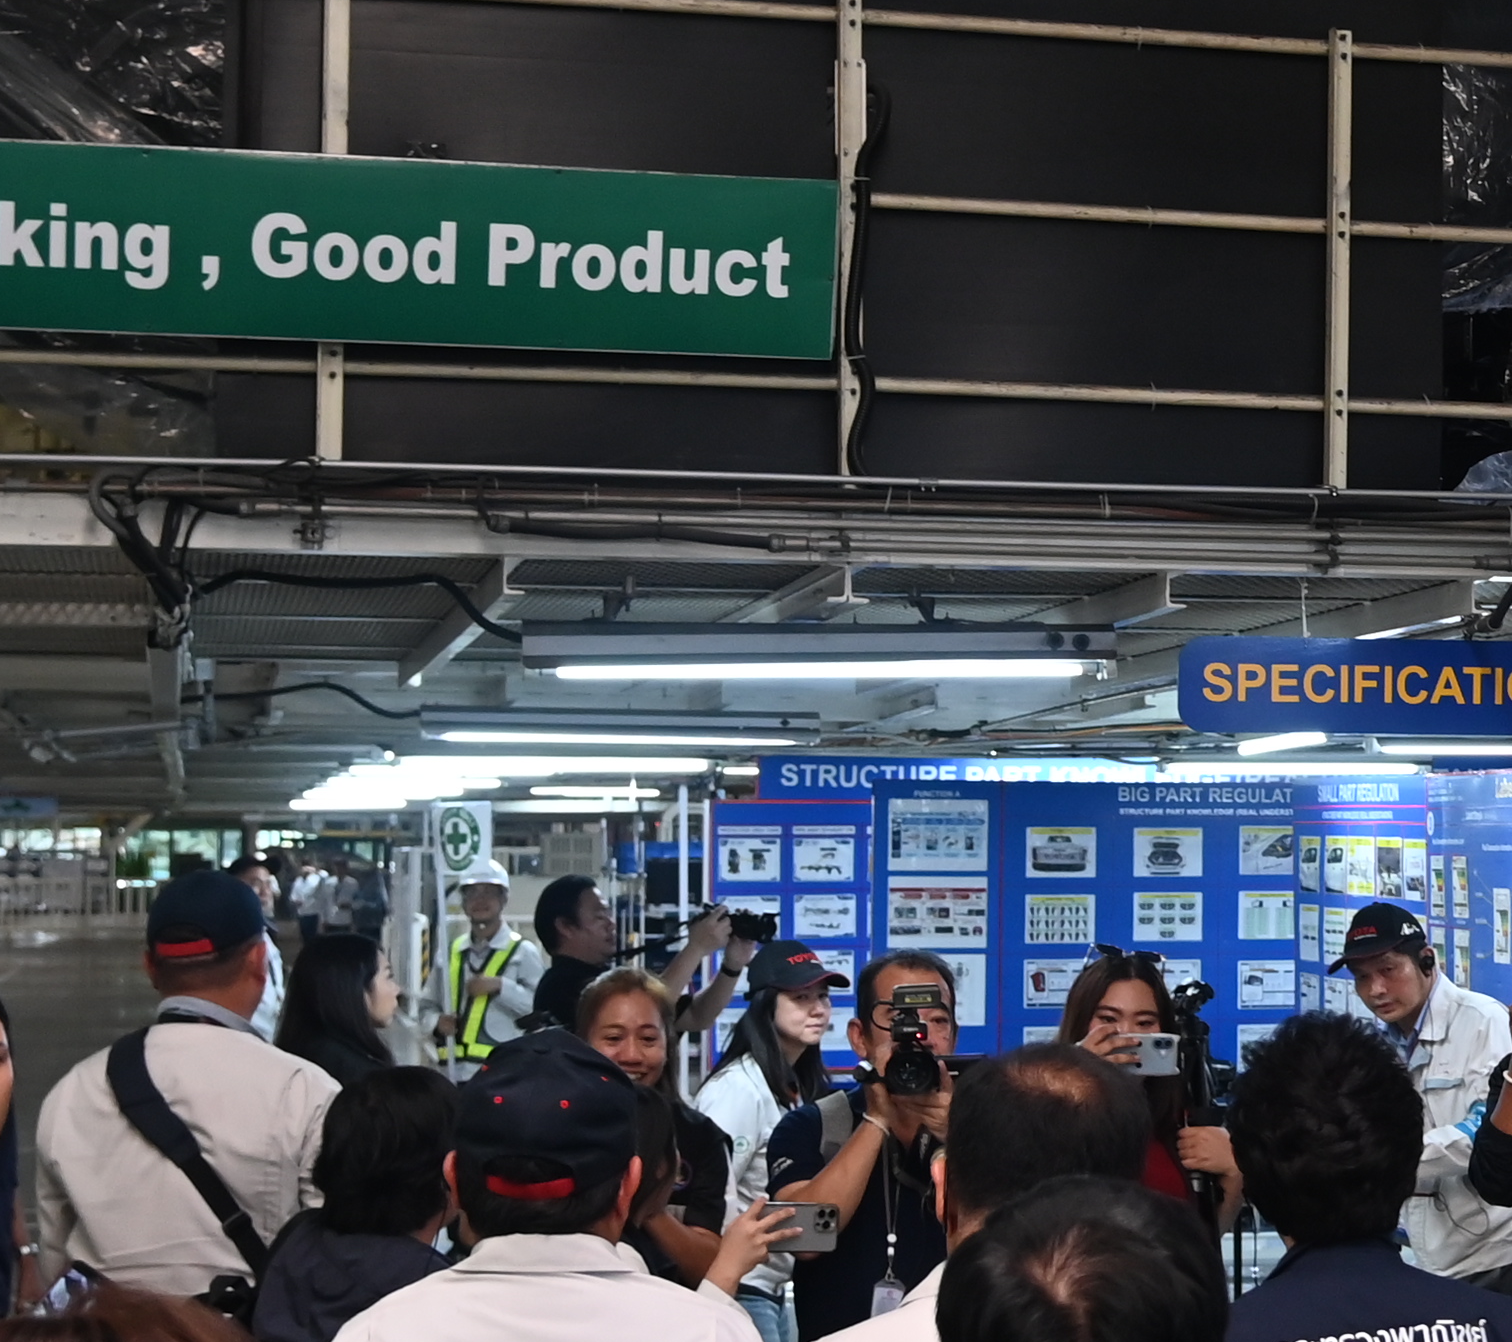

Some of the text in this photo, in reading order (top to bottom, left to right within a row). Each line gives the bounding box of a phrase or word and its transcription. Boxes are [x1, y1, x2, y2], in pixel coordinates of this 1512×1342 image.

[251, 213, 458, 285] Good
[487, 222, 791, 299] Product
[1118, 787, 1150, 802] BIG
[1155, 787, 1203, 802] PART
